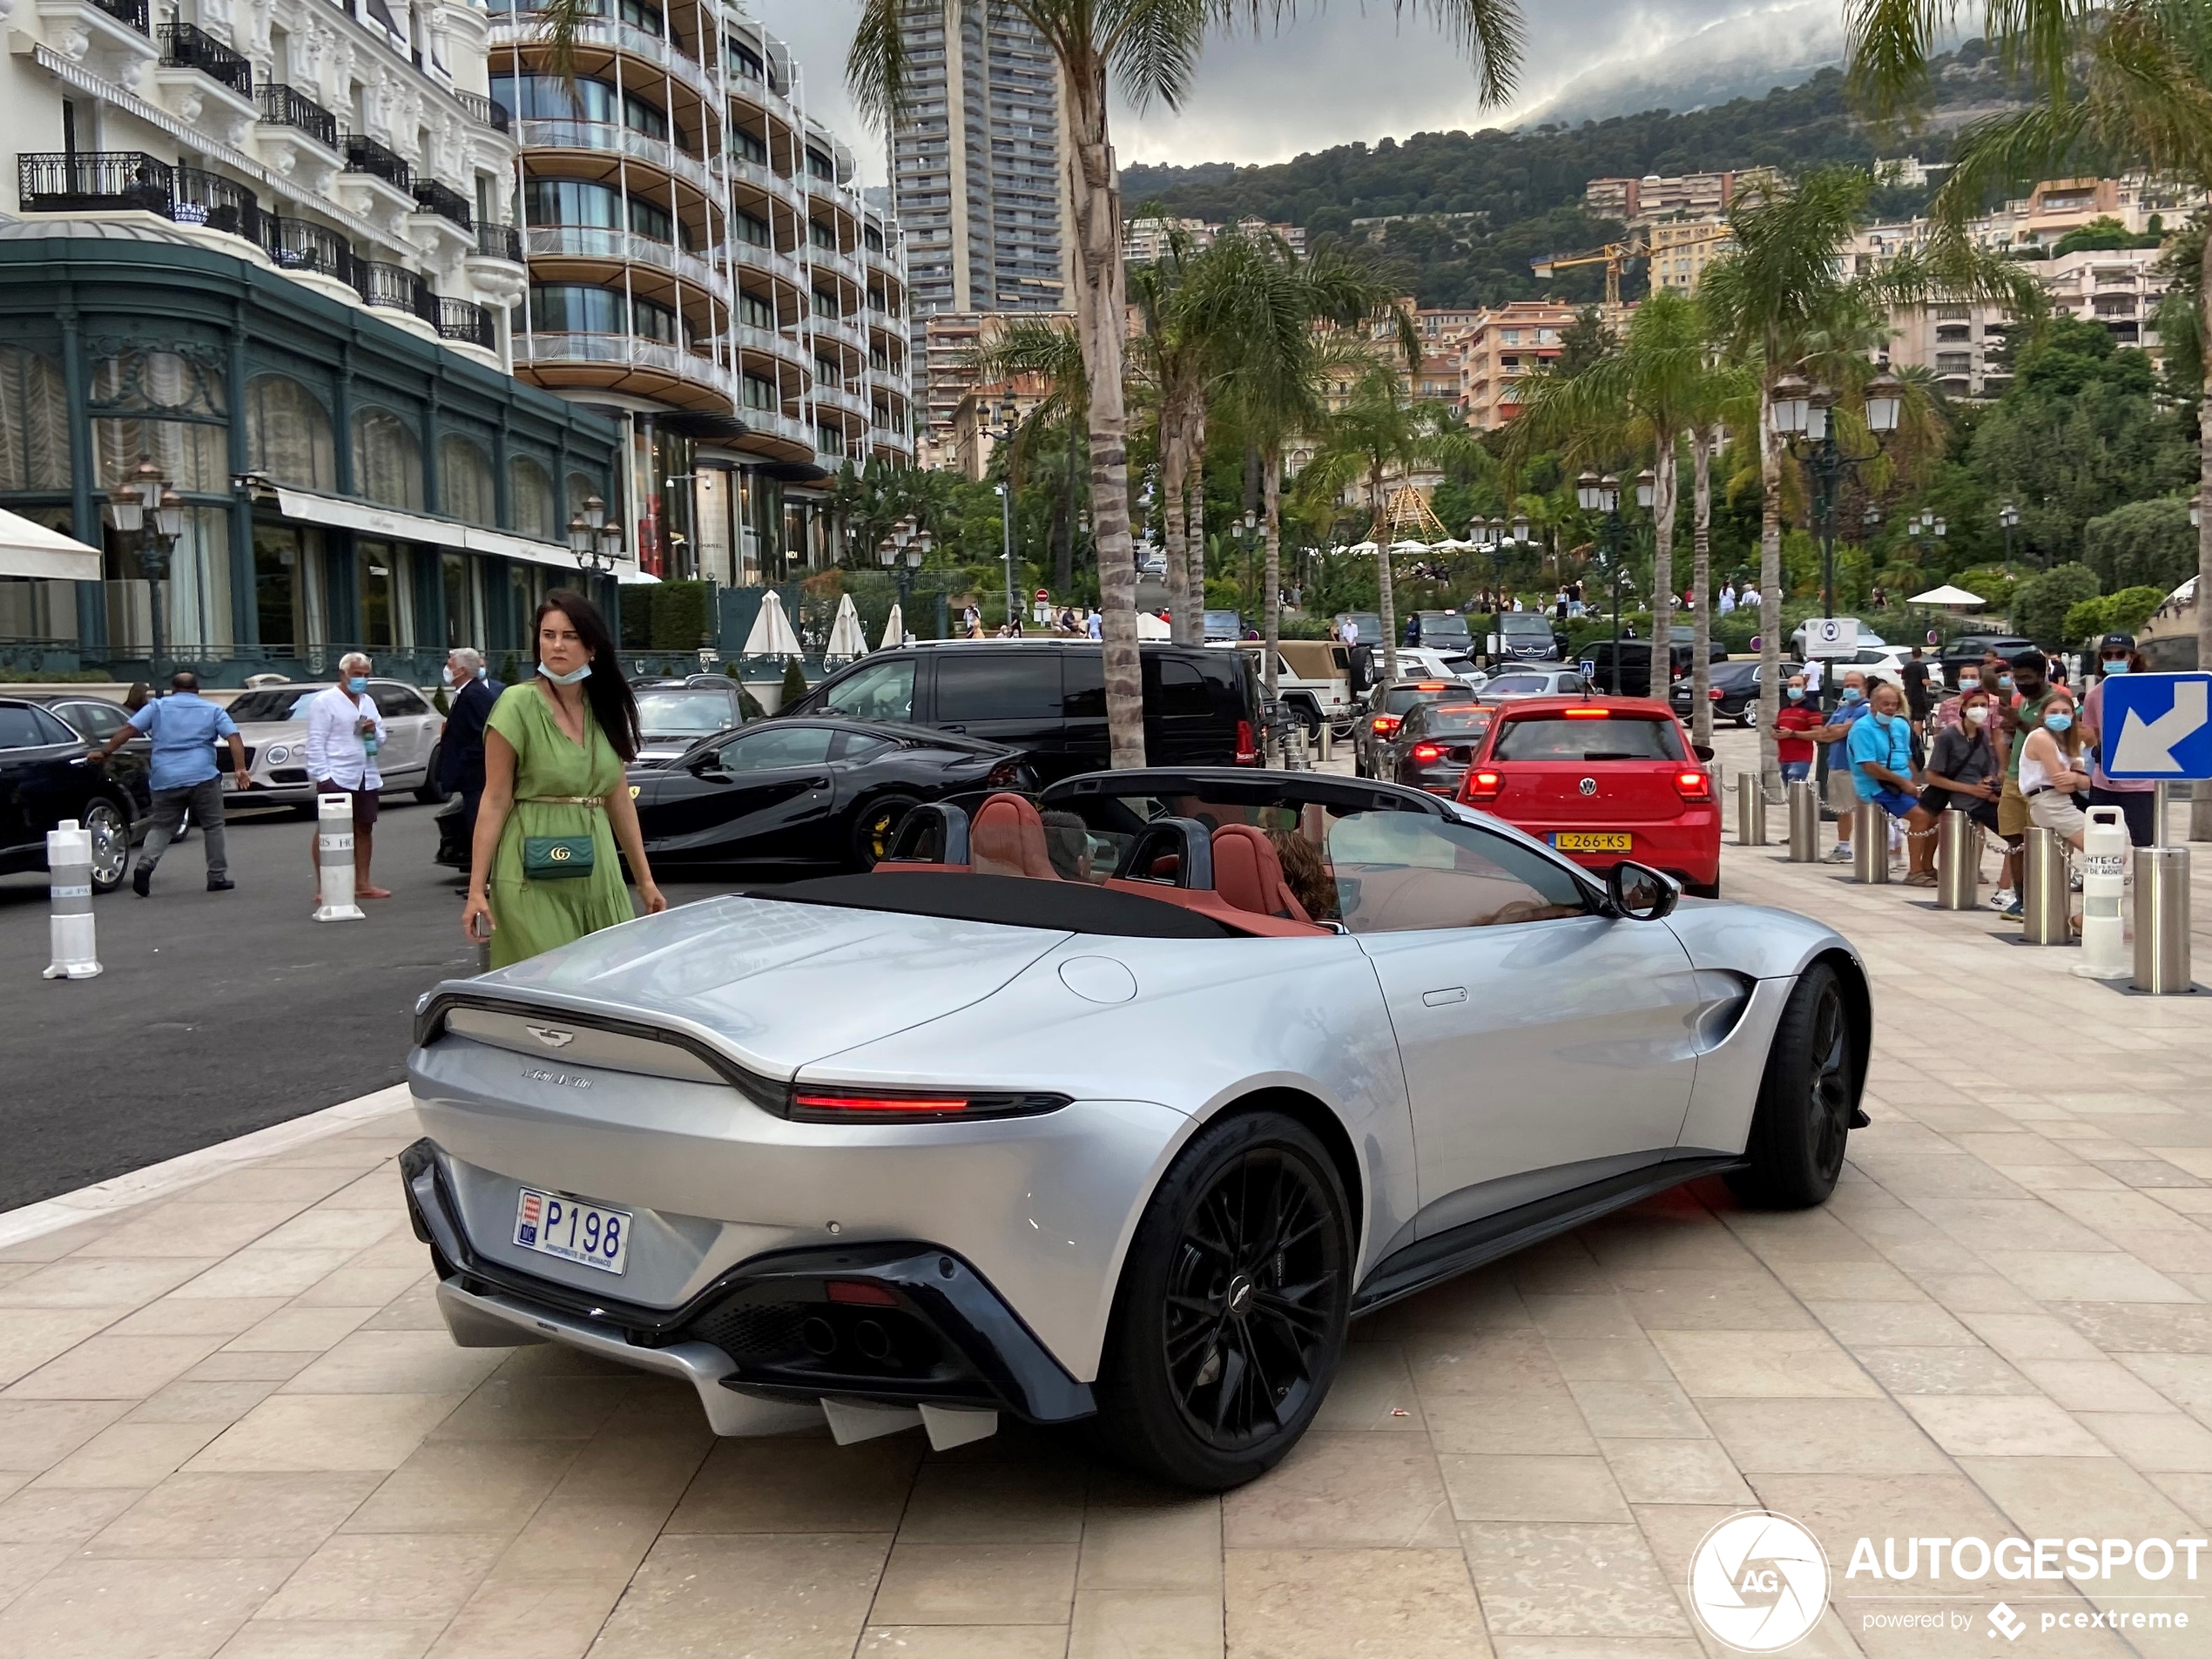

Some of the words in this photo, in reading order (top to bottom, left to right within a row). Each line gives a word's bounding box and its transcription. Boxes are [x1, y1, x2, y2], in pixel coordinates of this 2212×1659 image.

[1560, 834, 1625, 848] L-266-KS
[522, 1226, 535, 1241] MC
[544, 1200, 621, 1258] P198
